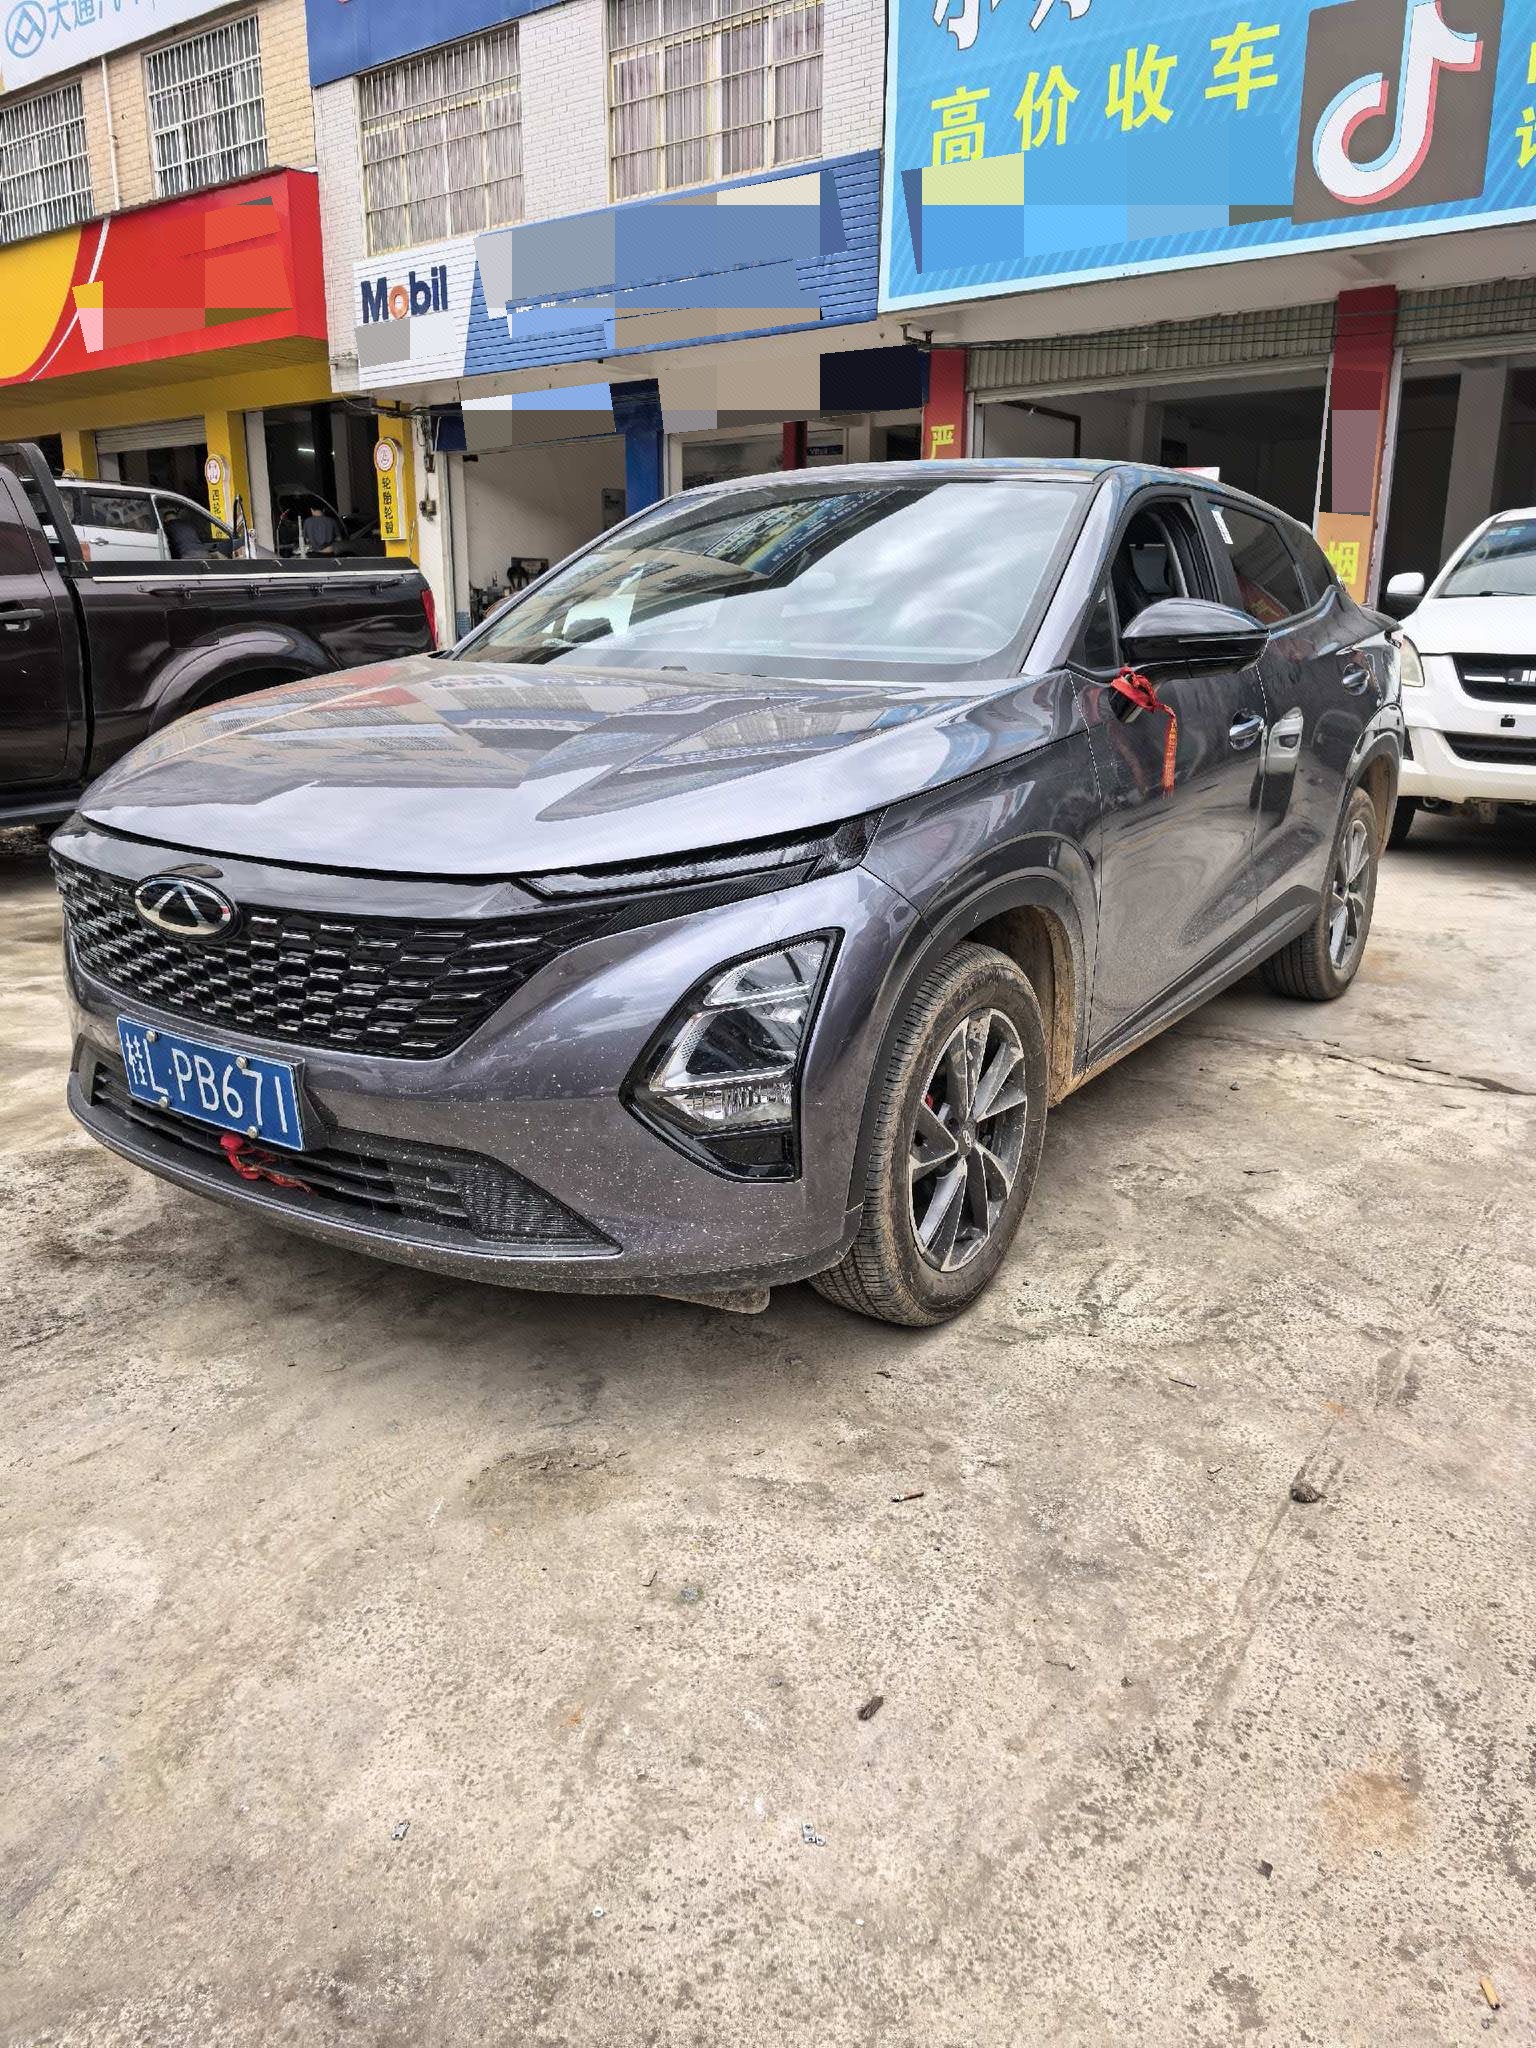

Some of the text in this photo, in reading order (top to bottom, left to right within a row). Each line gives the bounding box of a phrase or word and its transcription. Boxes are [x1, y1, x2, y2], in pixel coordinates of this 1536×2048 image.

[930, 22, 1281, 167] 高价收车
[360, 264, 449, 324] Mobil
